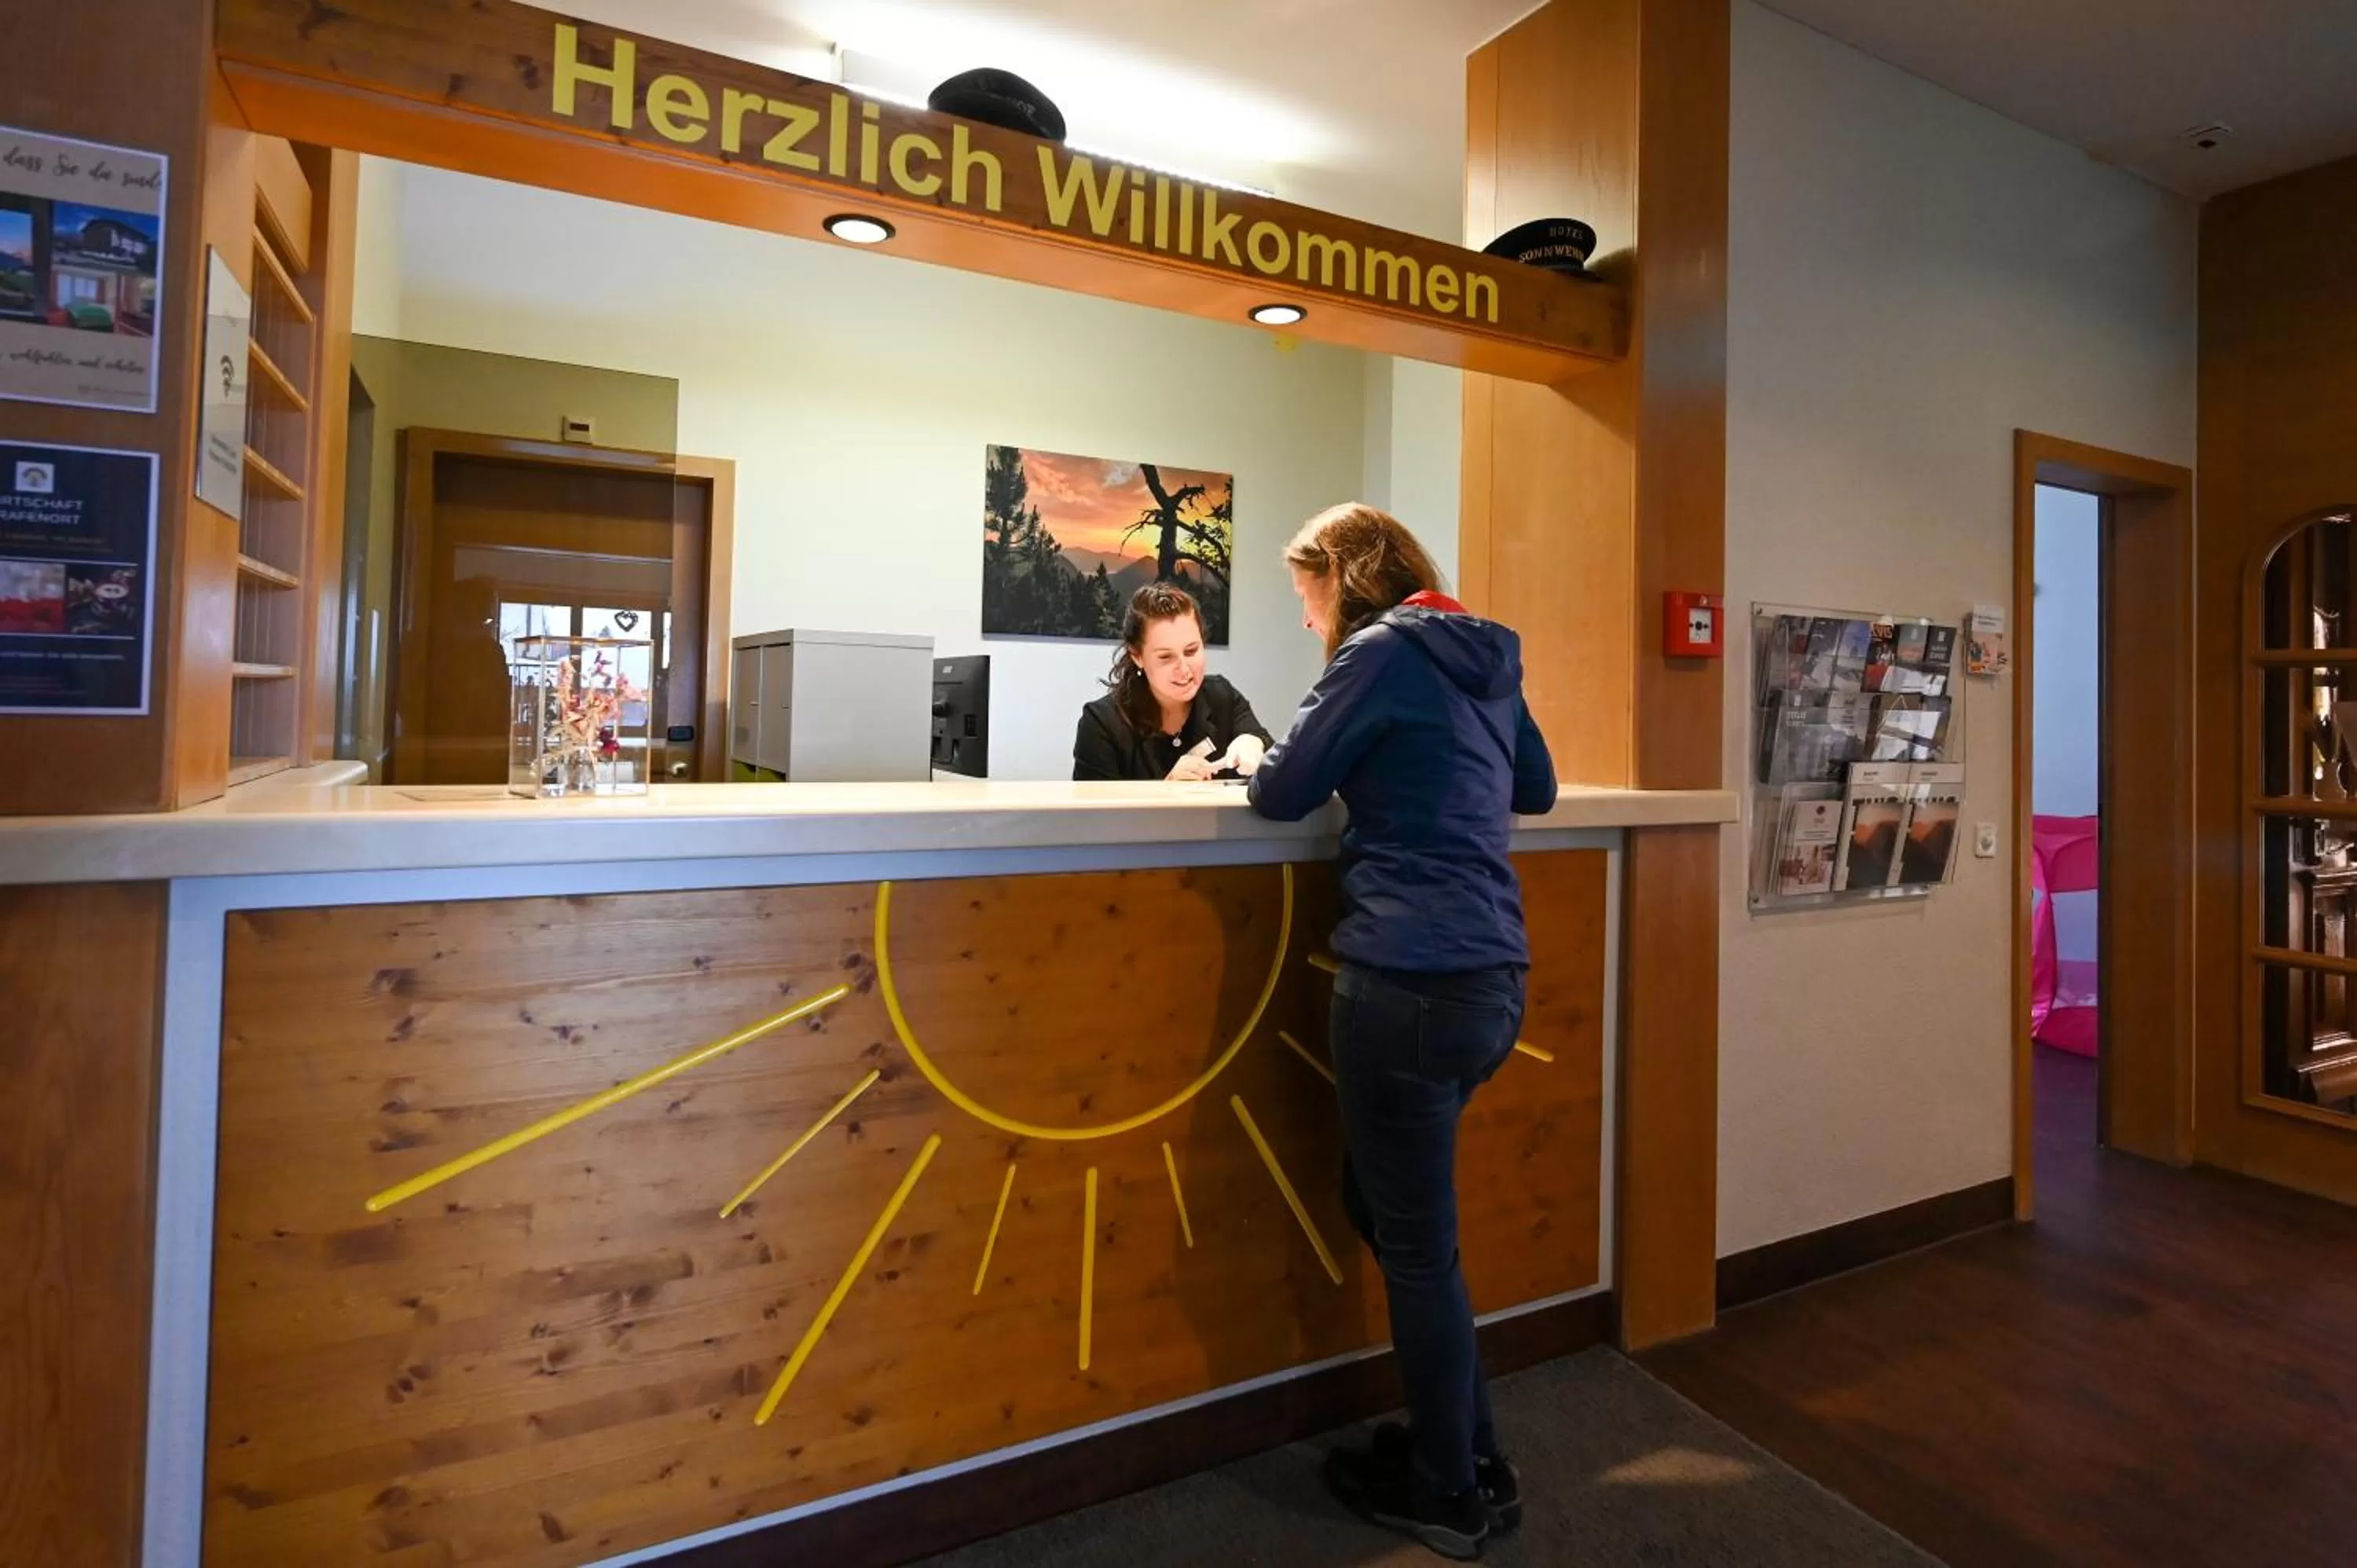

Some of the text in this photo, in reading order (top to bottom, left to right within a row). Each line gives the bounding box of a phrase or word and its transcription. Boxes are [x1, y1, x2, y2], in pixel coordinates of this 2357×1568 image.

[552, 22, 1499, 324] Herzlich Willkommen
[1549, 225, 1583, 240] HOTEL
